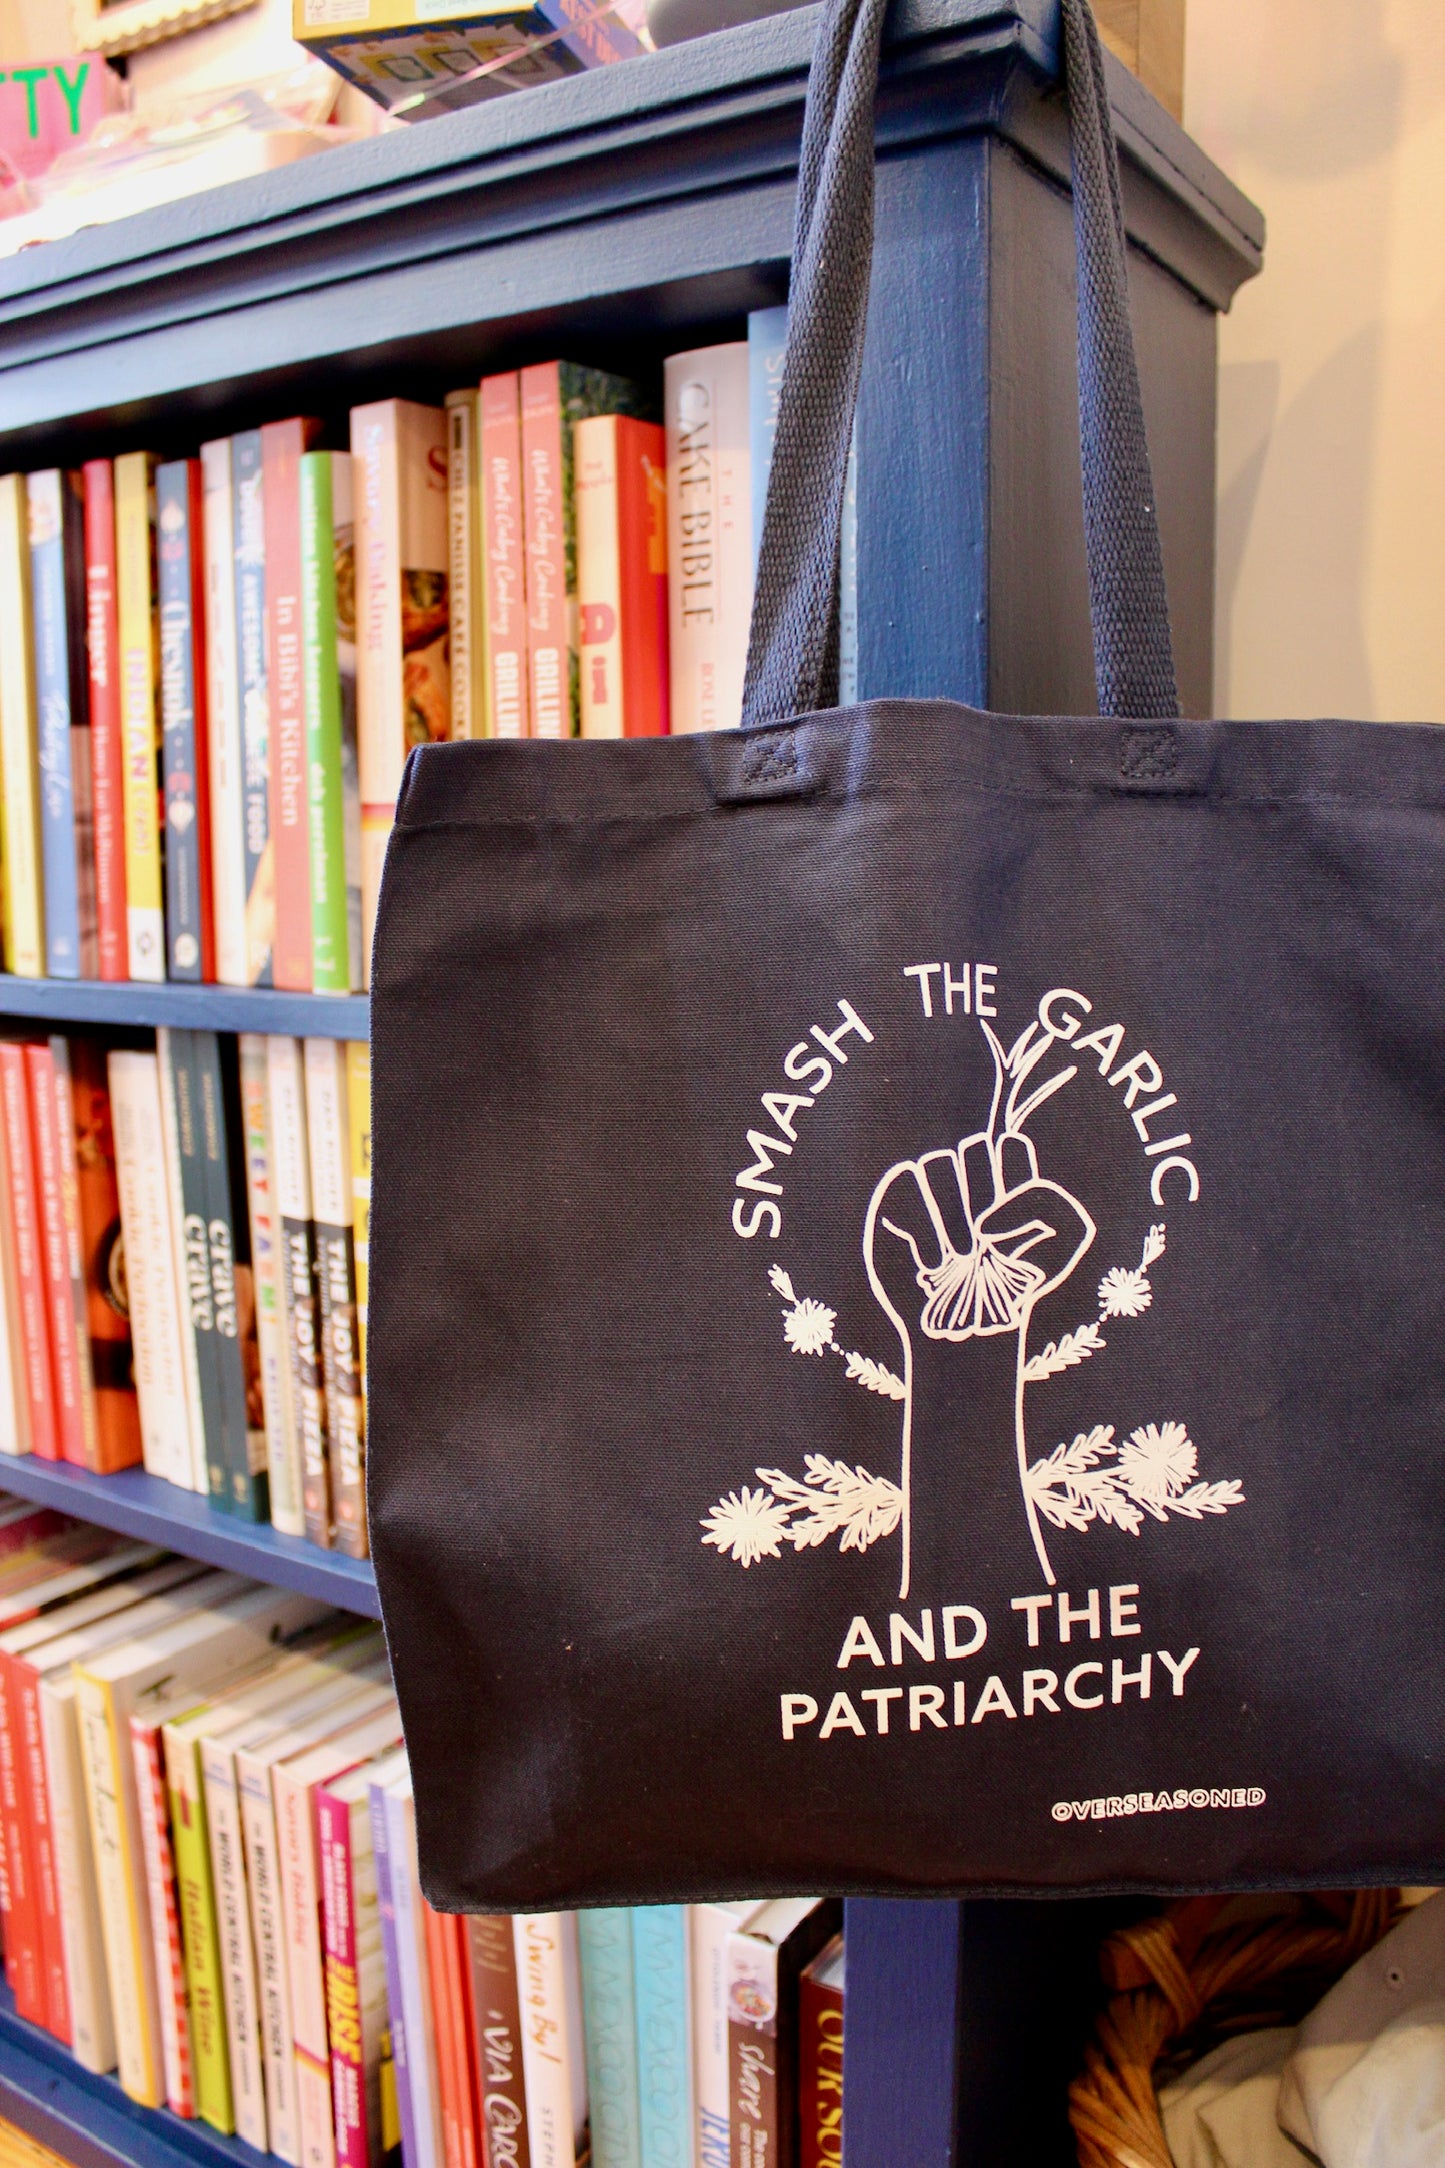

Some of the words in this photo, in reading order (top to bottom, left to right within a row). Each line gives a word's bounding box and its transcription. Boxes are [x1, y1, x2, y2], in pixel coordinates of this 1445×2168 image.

[0, 63, 90, 139] TY
[678, 383, 712, 500] CAKE
[721, 469, 734, 529] THE
[278, 595, 297, 624] In
[680, 510, 714, 628] BIBLE
[88, 564, 110, 687] Linger
[161, 599, 191, 732] Chesnok
[278, 632, 299, 711] Bibi's
[125, 647, 154, 779] INDIAN
[280, 718, 302, 826] Kitchen
[247, 792, 266, 854] FOOD
[246, 1080, 272, 1193] SWEET
[732, 999, 875, 1239] SMASH
[903, 962, 998, 1018] THE
[1038, 988, 1200, 1207] GARLIC
[184, 1213, 214, 1331] crave
[208, 1219, 238, 1338] crave
[252, 1213, 279, 1326] FARM!
[287, 1231, 311, 1296] THE
[327, 1238, 351, 1301] THE
[293, 1307, 315, 1366] JOY
[330, 1315, 355, 1376] JOY
[299, 1385, 324, 1478] PIZZA
[337, 1394, 362, 1487] PIZZA
[836, 1604, 988, 1669] AND
[1010, 1584, 1142, 1647] THE
[779, 1647, 1201, 1741] PATRIARCHY
[1051, 1787, 1267, 1822] OVERSEASONED
[218, 1831, 236, 1890] WORLD
[253, 1844, 270, 1905] WORLD
[186, 1878, 205, 1971] Italian
[196, 1985, 214, 2057] Wine
[224, 1894, 242, 1968] CENTRAL
[260, 1908, 277, 1982] CENTRAL
[526, 1924, 556, 2008] Swing
[231, 1972, 249, 2044] KITCHEN
[266, 1986, 284, 2059] KITCHEN
[329, 1978, 362, 2063] RISE
[531, 2014, 563, 2064] By!
[484, 2026, 514, 2083] VIA
[737, 2043, 775, 2120] share
[817, 2008, 844, 2095] OUR
